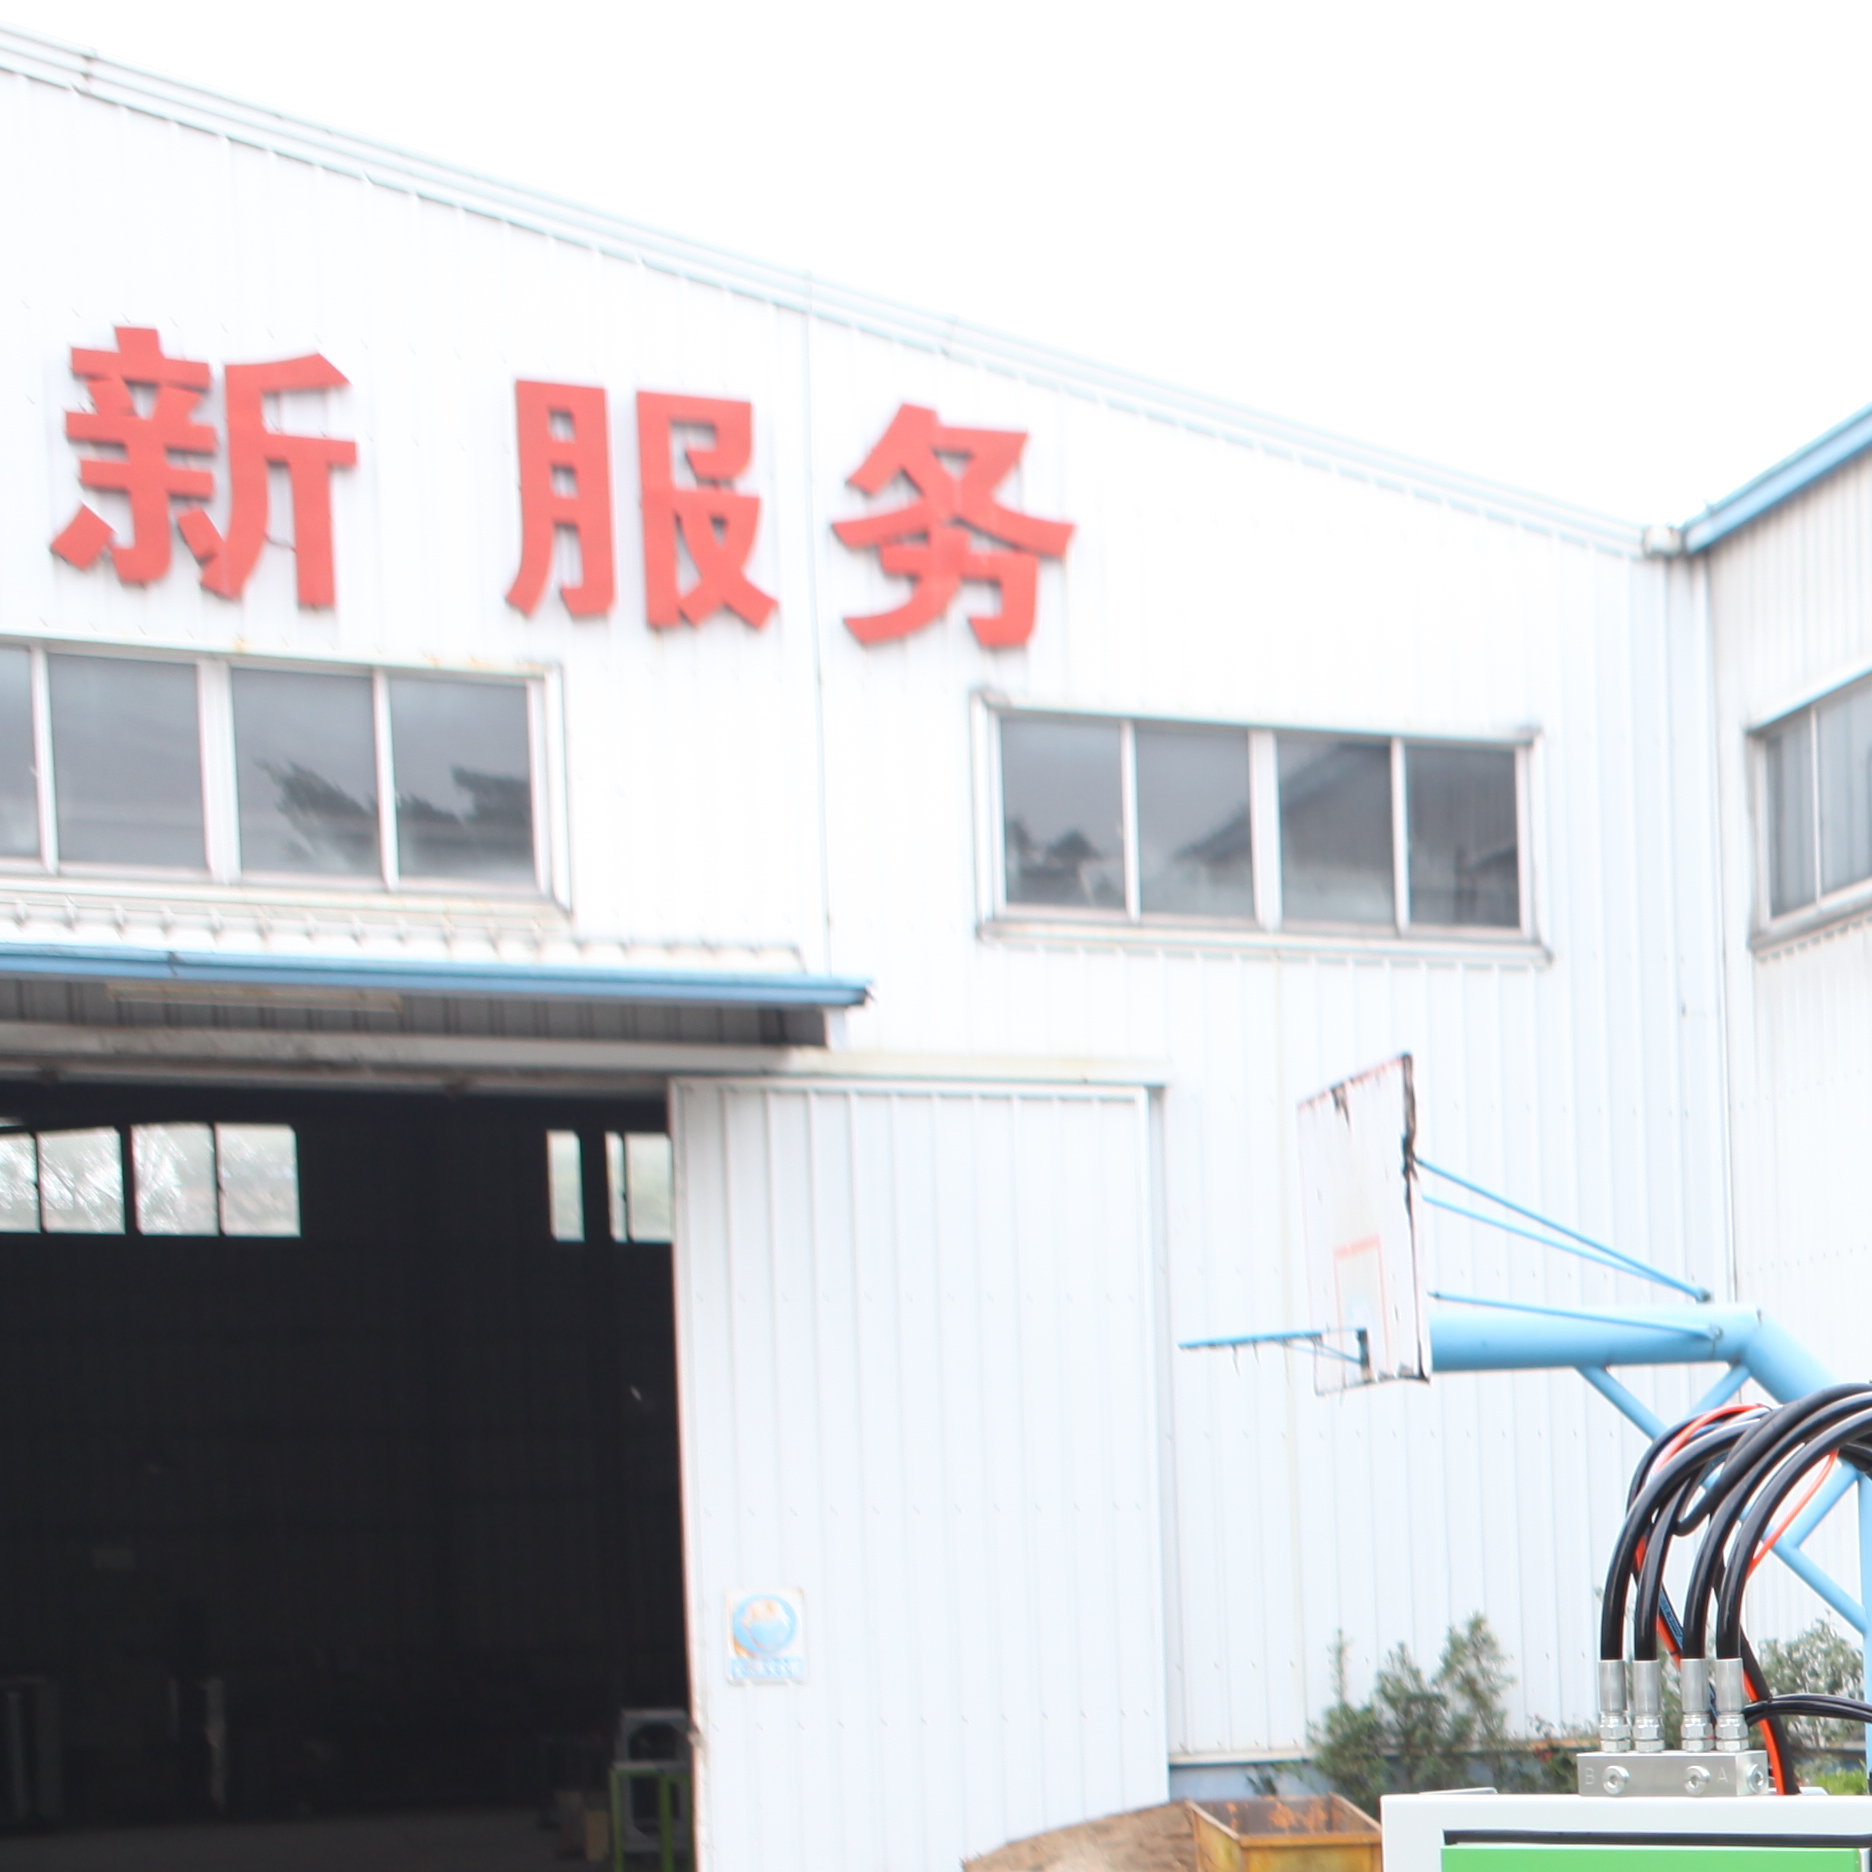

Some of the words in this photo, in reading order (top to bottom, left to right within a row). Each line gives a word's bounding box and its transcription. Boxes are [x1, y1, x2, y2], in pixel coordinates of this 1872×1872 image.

[50, 326, 1075, 649] 新服务
[1716, 1767, 1729, 1784] A
